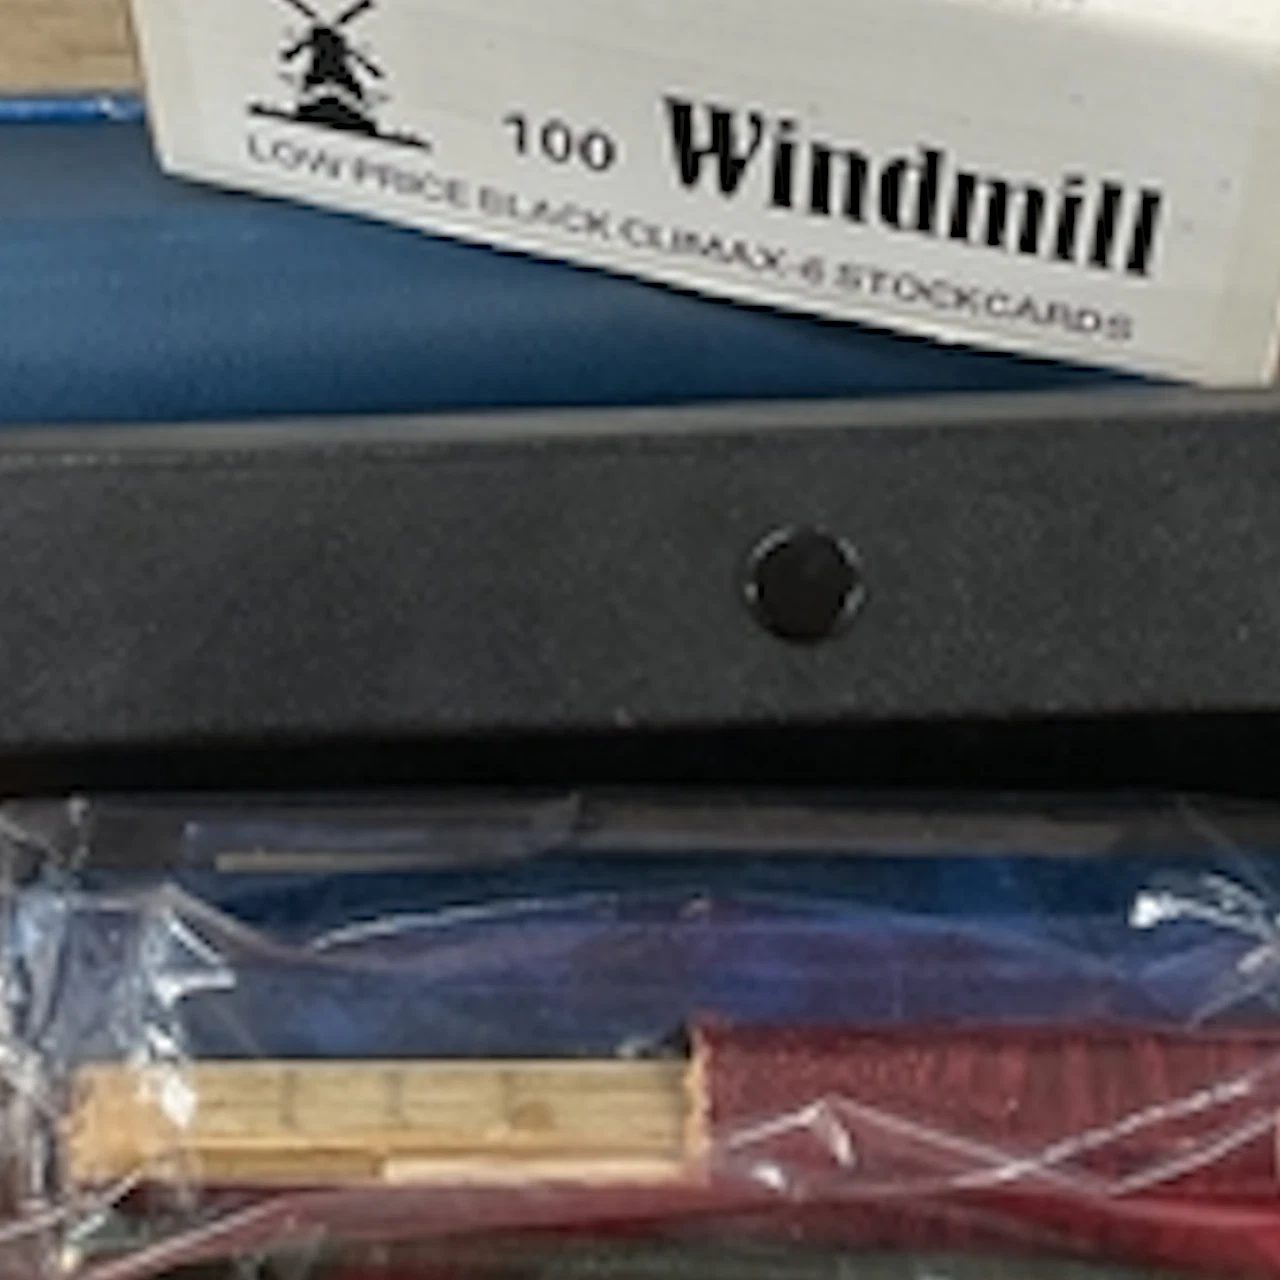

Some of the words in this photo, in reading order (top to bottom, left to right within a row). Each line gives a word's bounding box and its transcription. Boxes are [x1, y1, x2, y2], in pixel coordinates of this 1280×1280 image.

[246, 131, 341, 181] LOW
[352, 156, 470, 210] PRICE
[477, 186, 613, 243] BLACK
[619, 216, 828, 286] CLIMAX-6
[834, 261, 1135, 343] STOCKCARDS
[500, 109, 616, 174] 100
[662, 93, 1163, 278] Windmill
